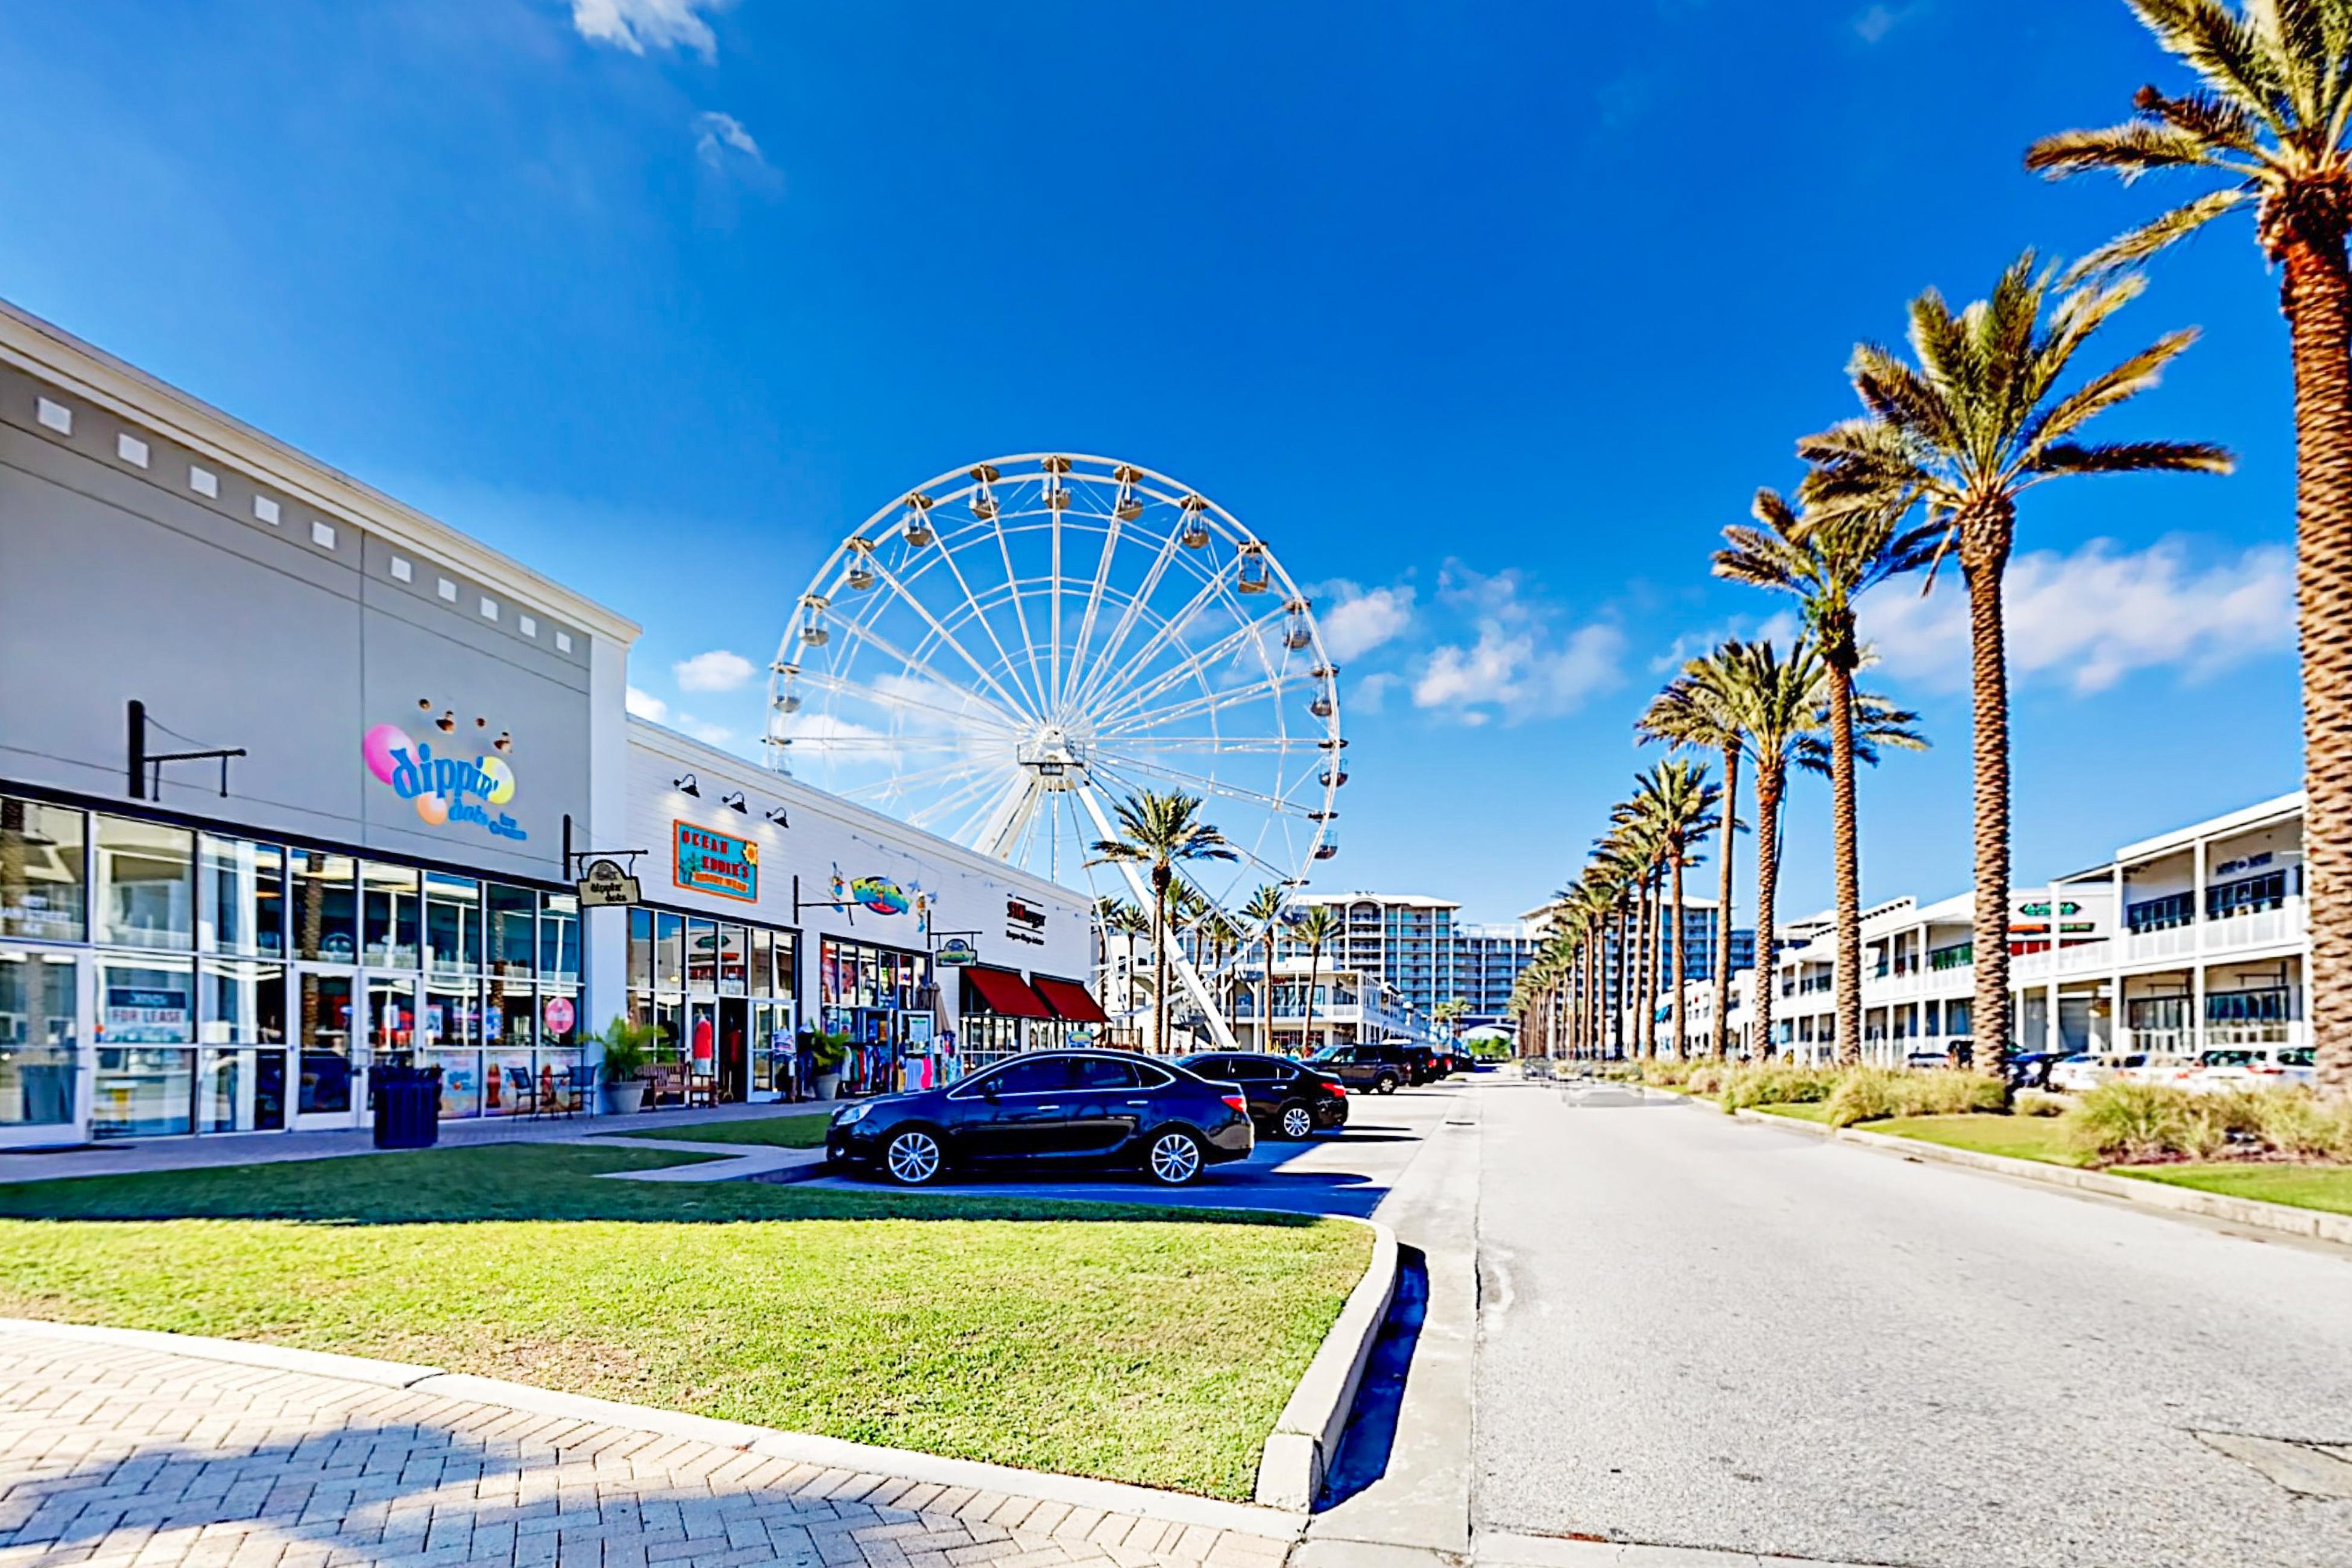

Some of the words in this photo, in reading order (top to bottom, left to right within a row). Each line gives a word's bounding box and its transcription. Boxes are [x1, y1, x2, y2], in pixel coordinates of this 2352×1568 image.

[389, 743, 499, 801] dippin'
[448, 797, 488, 826] dots
[682, 830, 728, 854] OCEAN
[702, 855, 748, 878] EDDIE'S
[112, 1009, 137, 1022] FOR
[143, 1010, 181, 1024] LEASE
